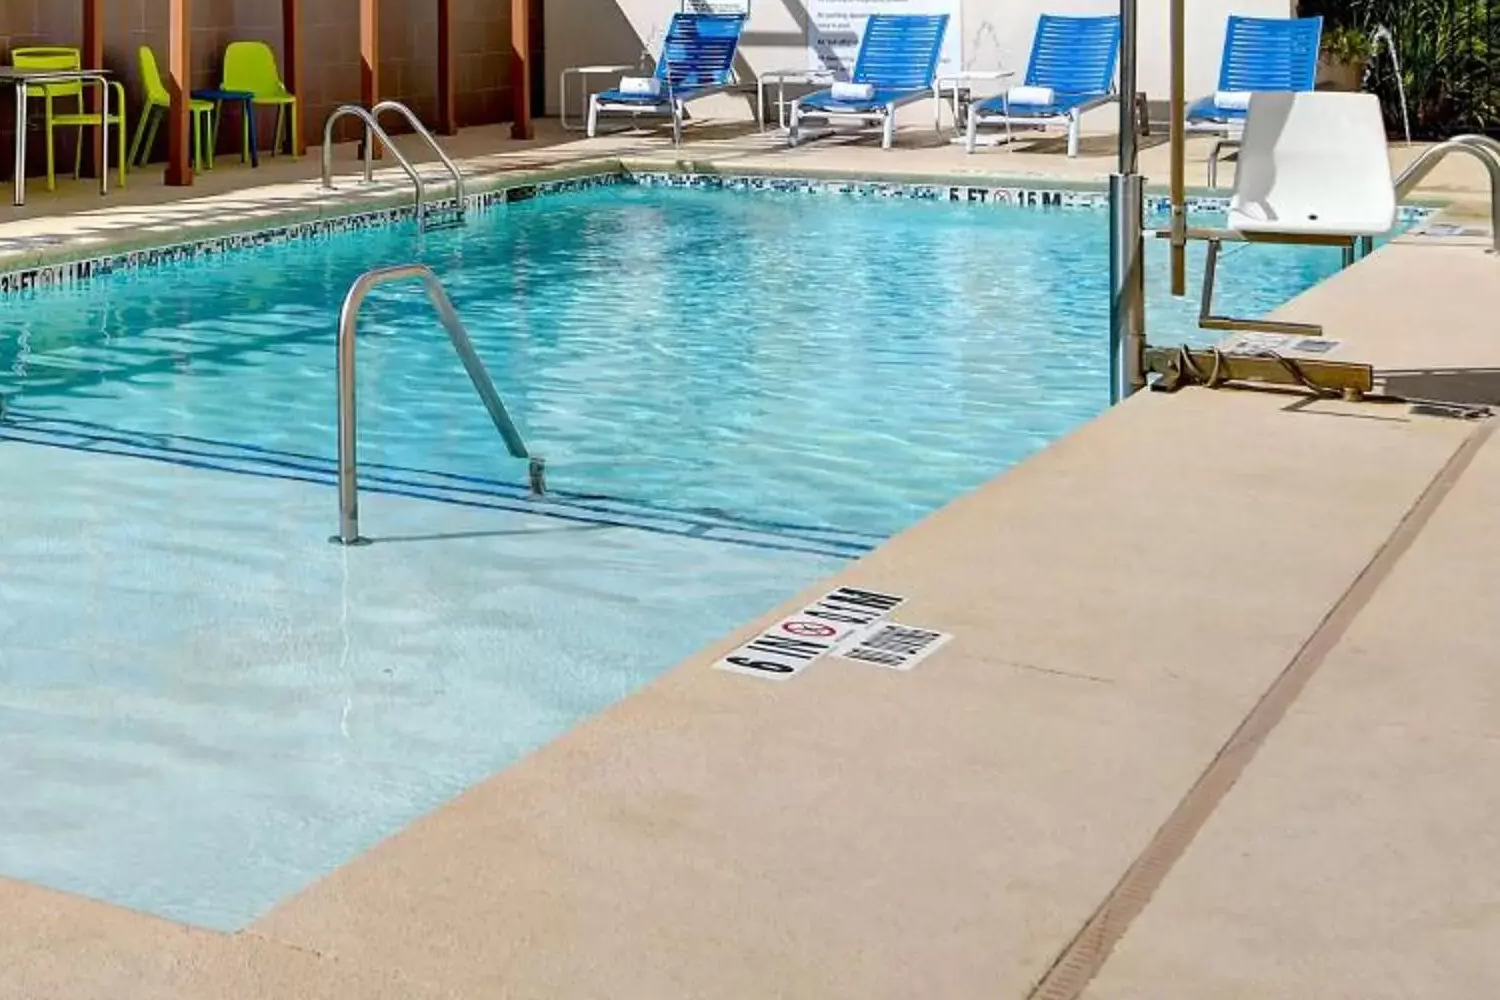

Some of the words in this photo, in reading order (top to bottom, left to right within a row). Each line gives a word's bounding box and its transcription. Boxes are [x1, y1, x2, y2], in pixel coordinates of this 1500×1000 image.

[967, 188, 988, 204] FT
[1043, 191, 1062, 207] M
[826, 586, 904, 611] M
[747, 634, 829, 660] IN
[725, 655, 794, 673] 6
